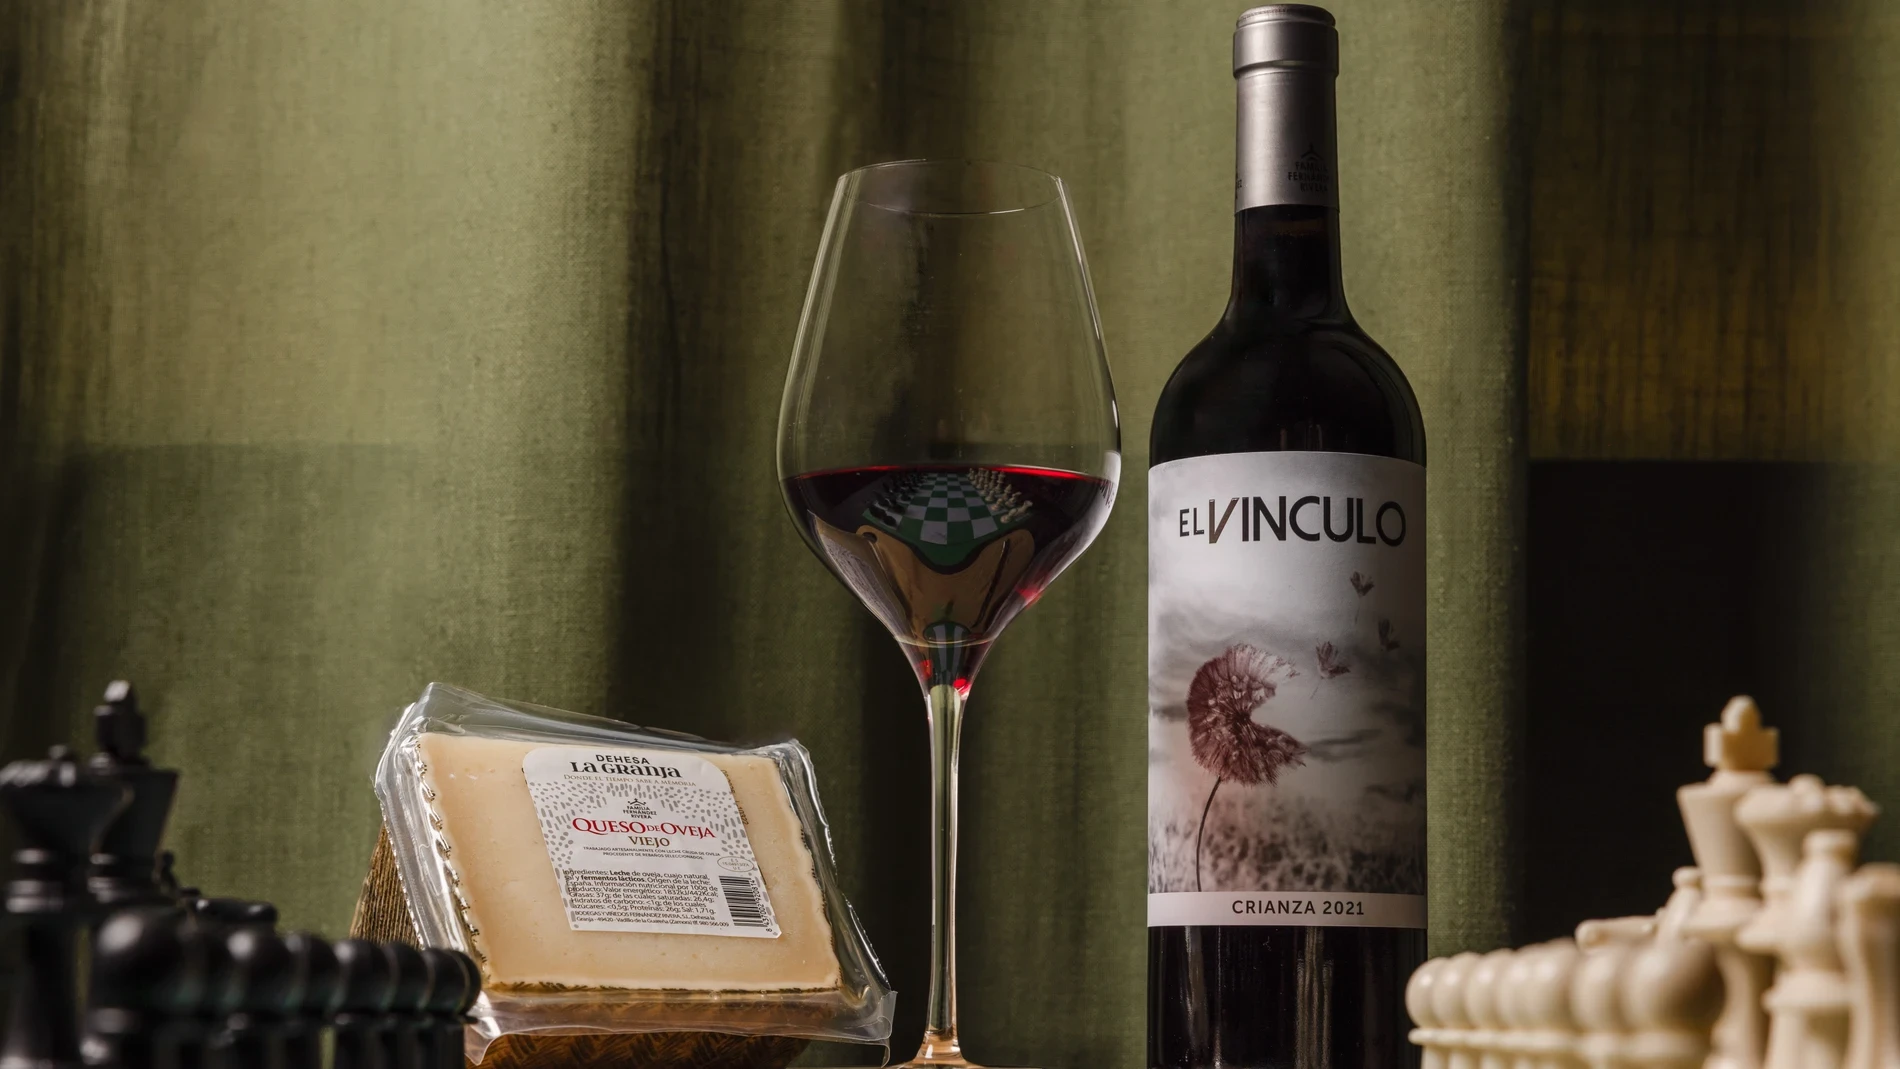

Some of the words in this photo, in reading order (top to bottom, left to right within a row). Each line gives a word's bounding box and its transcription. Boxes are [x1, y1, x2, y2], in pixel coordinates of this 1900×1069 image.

[1179, 508, 1205, 538] EL
[1208, 495, 1407, 547] VINCULO
[595, 754, 650, 764] DEHESA
[572, 818, 646, 836] QUESO
[660, 822, 716, 839] OVEJA
[628, 836, 670, 848] VIEJO
[1232, 899, 1316, 916] CRIANZA
[1322, 900, 1364, 916] 2021
